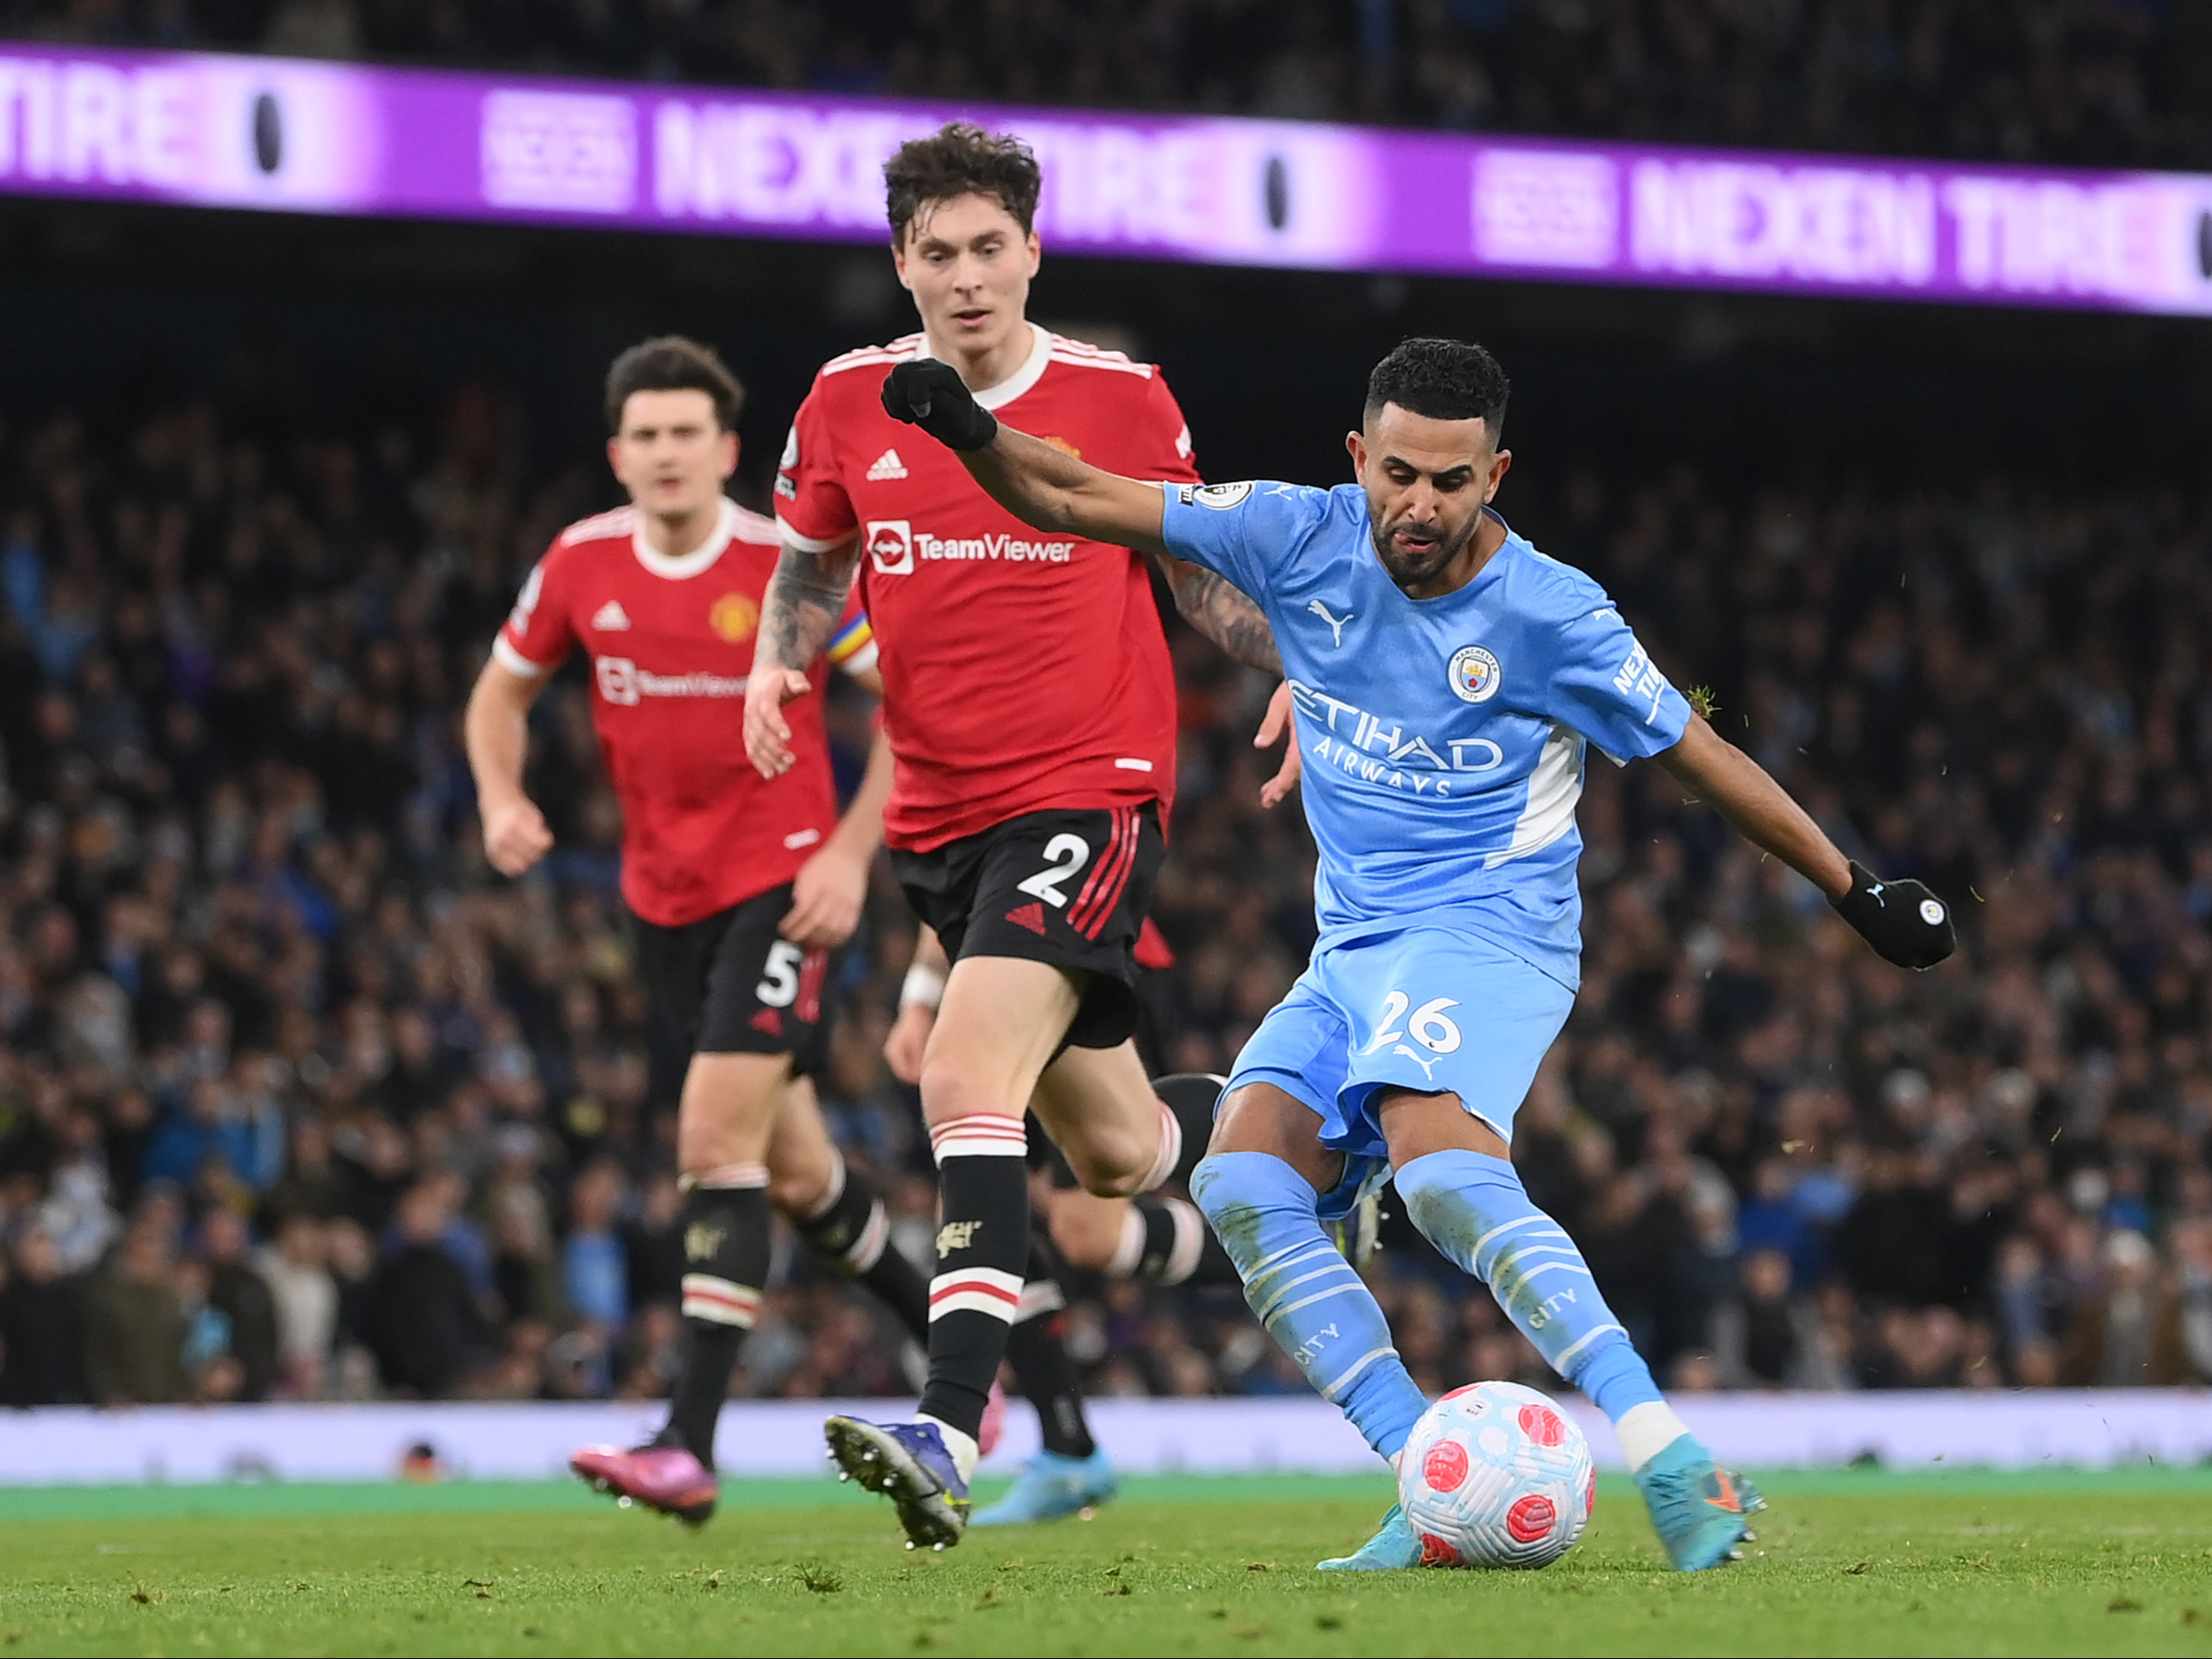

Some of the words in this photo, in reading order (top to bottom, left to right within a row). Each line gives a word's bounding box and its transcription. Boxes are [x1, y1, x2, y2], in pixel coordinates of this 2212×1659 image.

[1631, 160, 1935, 284] NEXEN
[1942, 175, 2158, 299] TIRE
[913, 533, 1076, 562] TeamViewer
[1454, 648, 1498, 673] MANCHESTER
[1287, 679, 1503, 772] ETIHAD
[1462, 691, 1479, 700] CITY
[1313, 736, 1451, 798] AIRWAYS
[1017, 832, 1091, 909] 2
[755, 939, 804, 1008] 5
[1357, 990, 1462, 1053] 26
[1528, 1287, 1577, 1329] CITY
[1292, 1322, 1341, 1367] CITY
